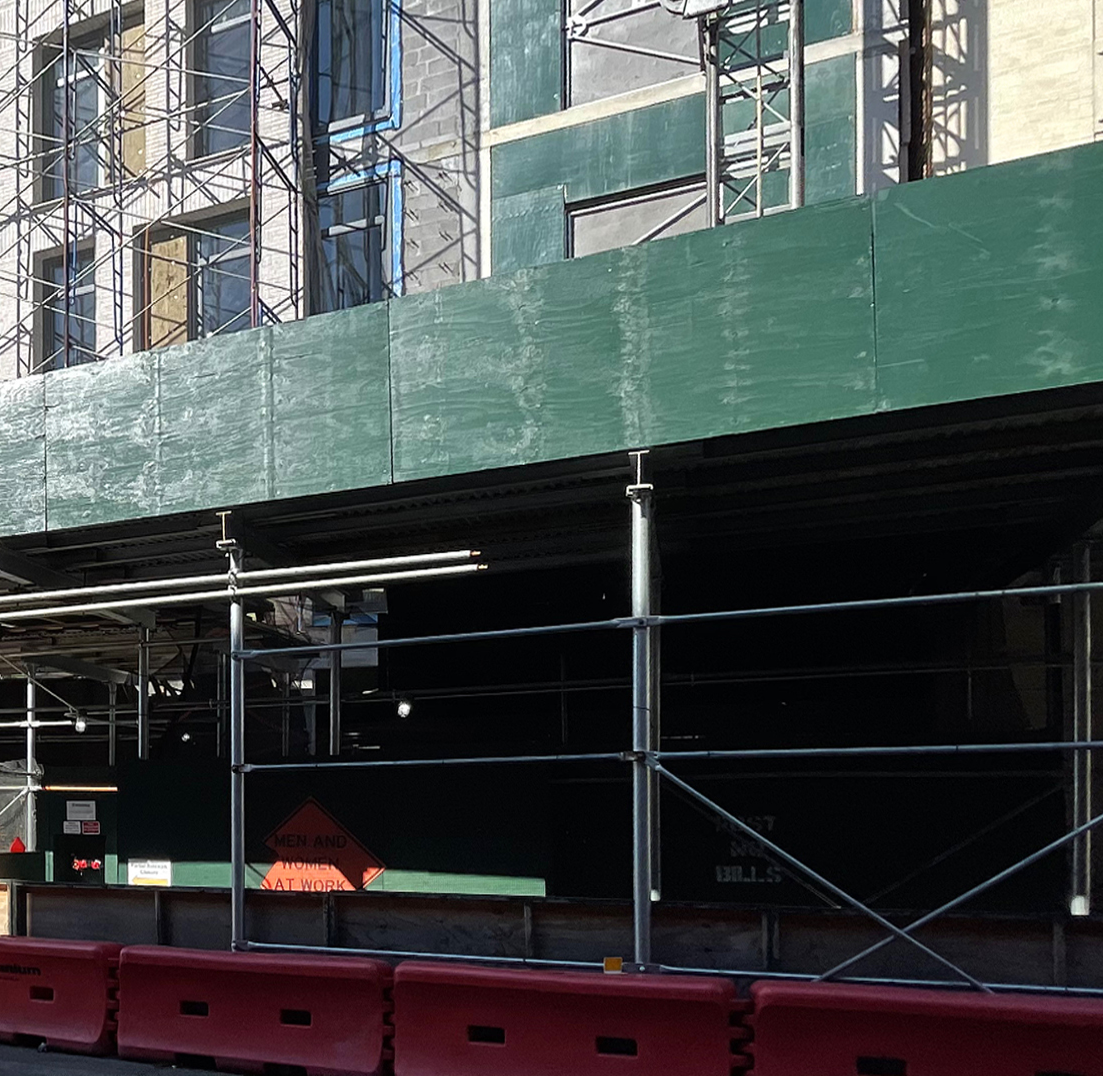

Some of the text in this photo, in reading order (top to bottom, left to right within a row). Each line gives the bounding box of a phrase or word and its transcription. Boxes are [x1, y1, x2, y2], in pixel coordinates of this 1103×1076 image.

[274, 834, 347, 849] MEN AND
[281, 856, 340, 871] WOMEN
[715, 865, 783, 883] BILLS
[274, 877, 346, 892] AT WORK
